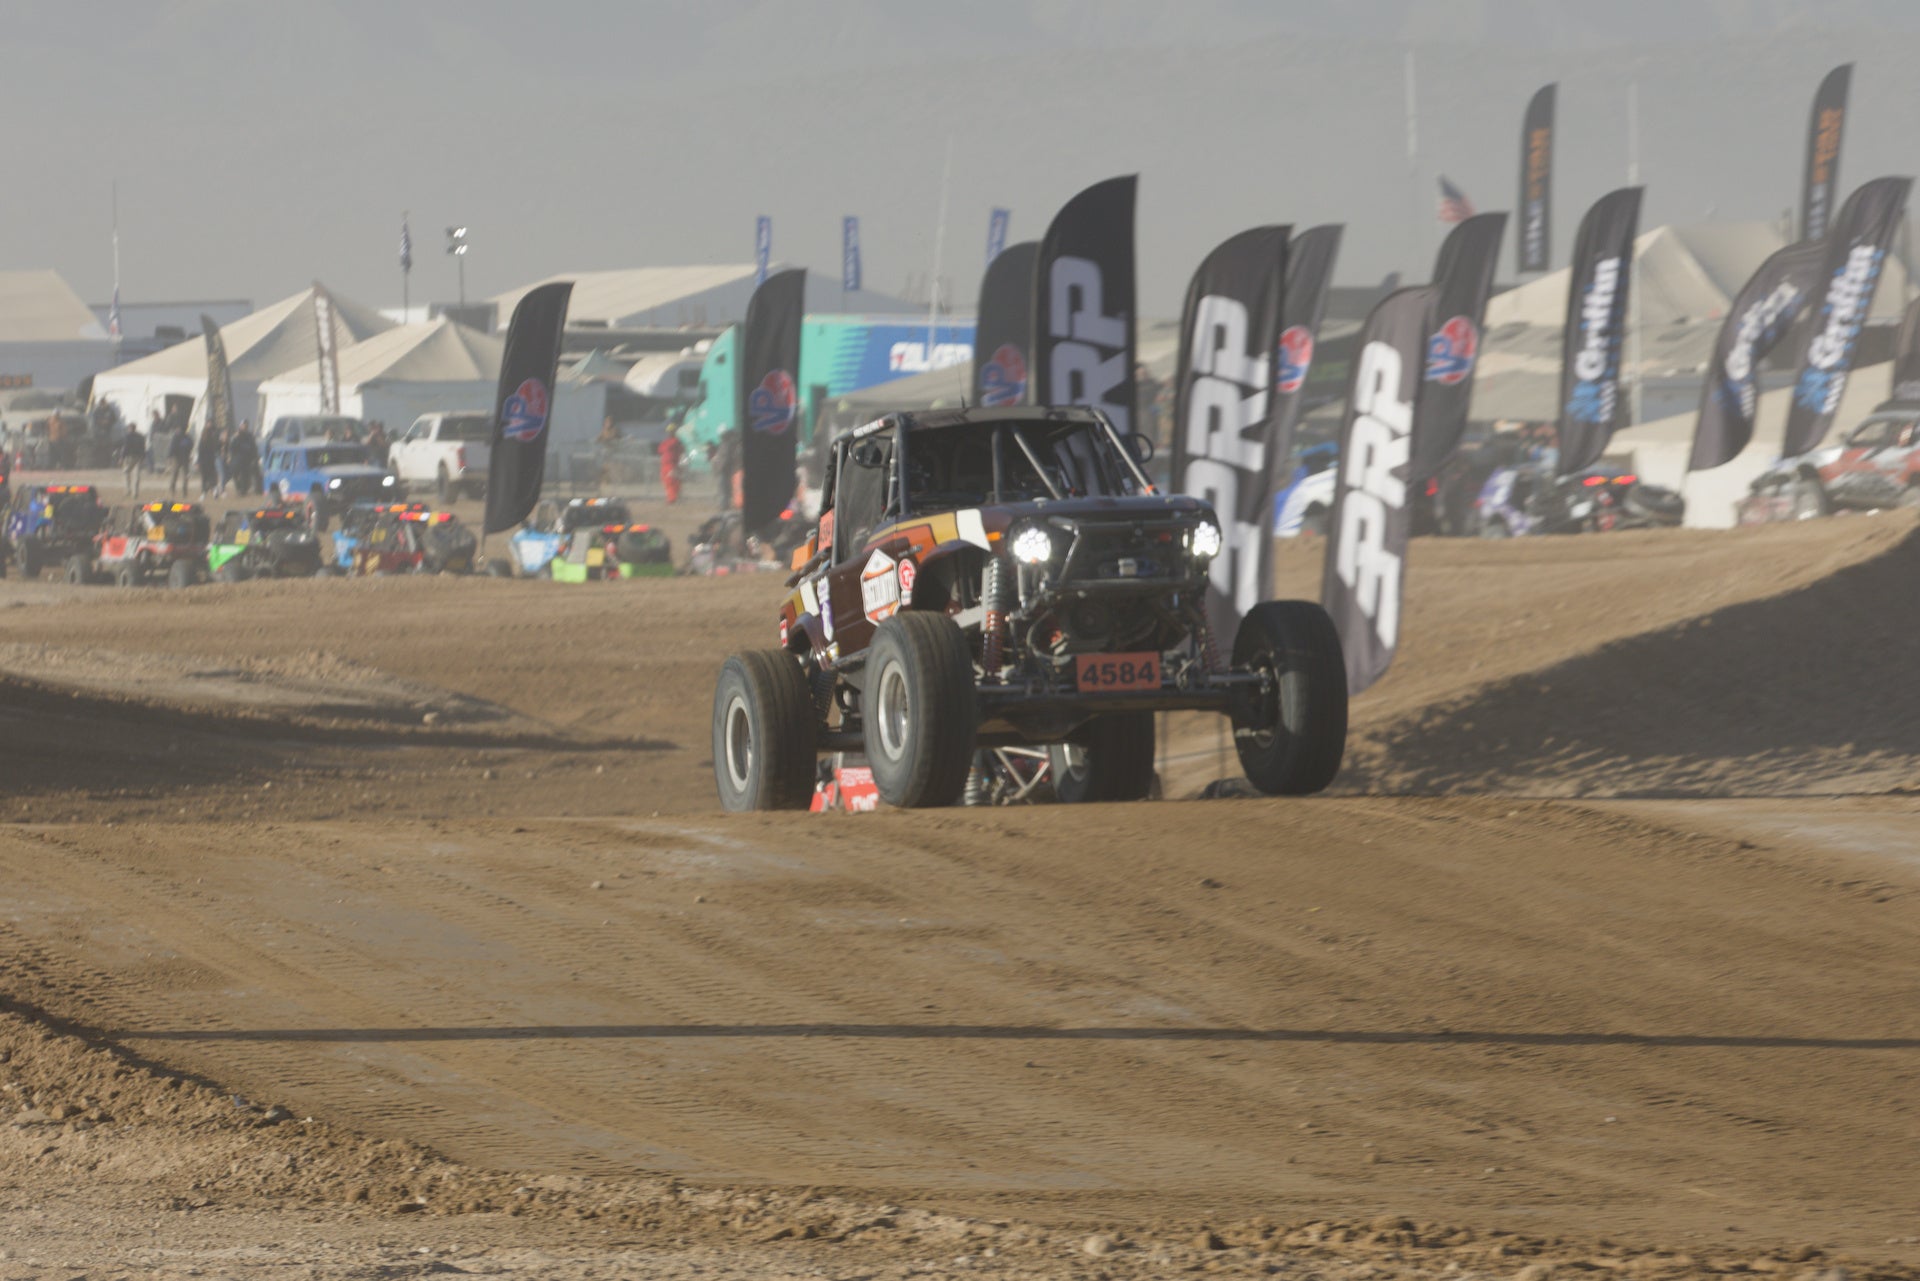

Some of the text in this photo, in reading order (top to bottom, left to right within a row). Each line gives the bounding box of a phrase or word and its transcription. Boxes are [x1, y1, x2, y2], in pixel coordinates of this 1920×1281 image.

[1424, 332, 1475, 383] VP
[503, 393, 547, 440] VP
[1337, 340, 1414, 650] PRP
[1082, 661, 1155, 686] 4584
